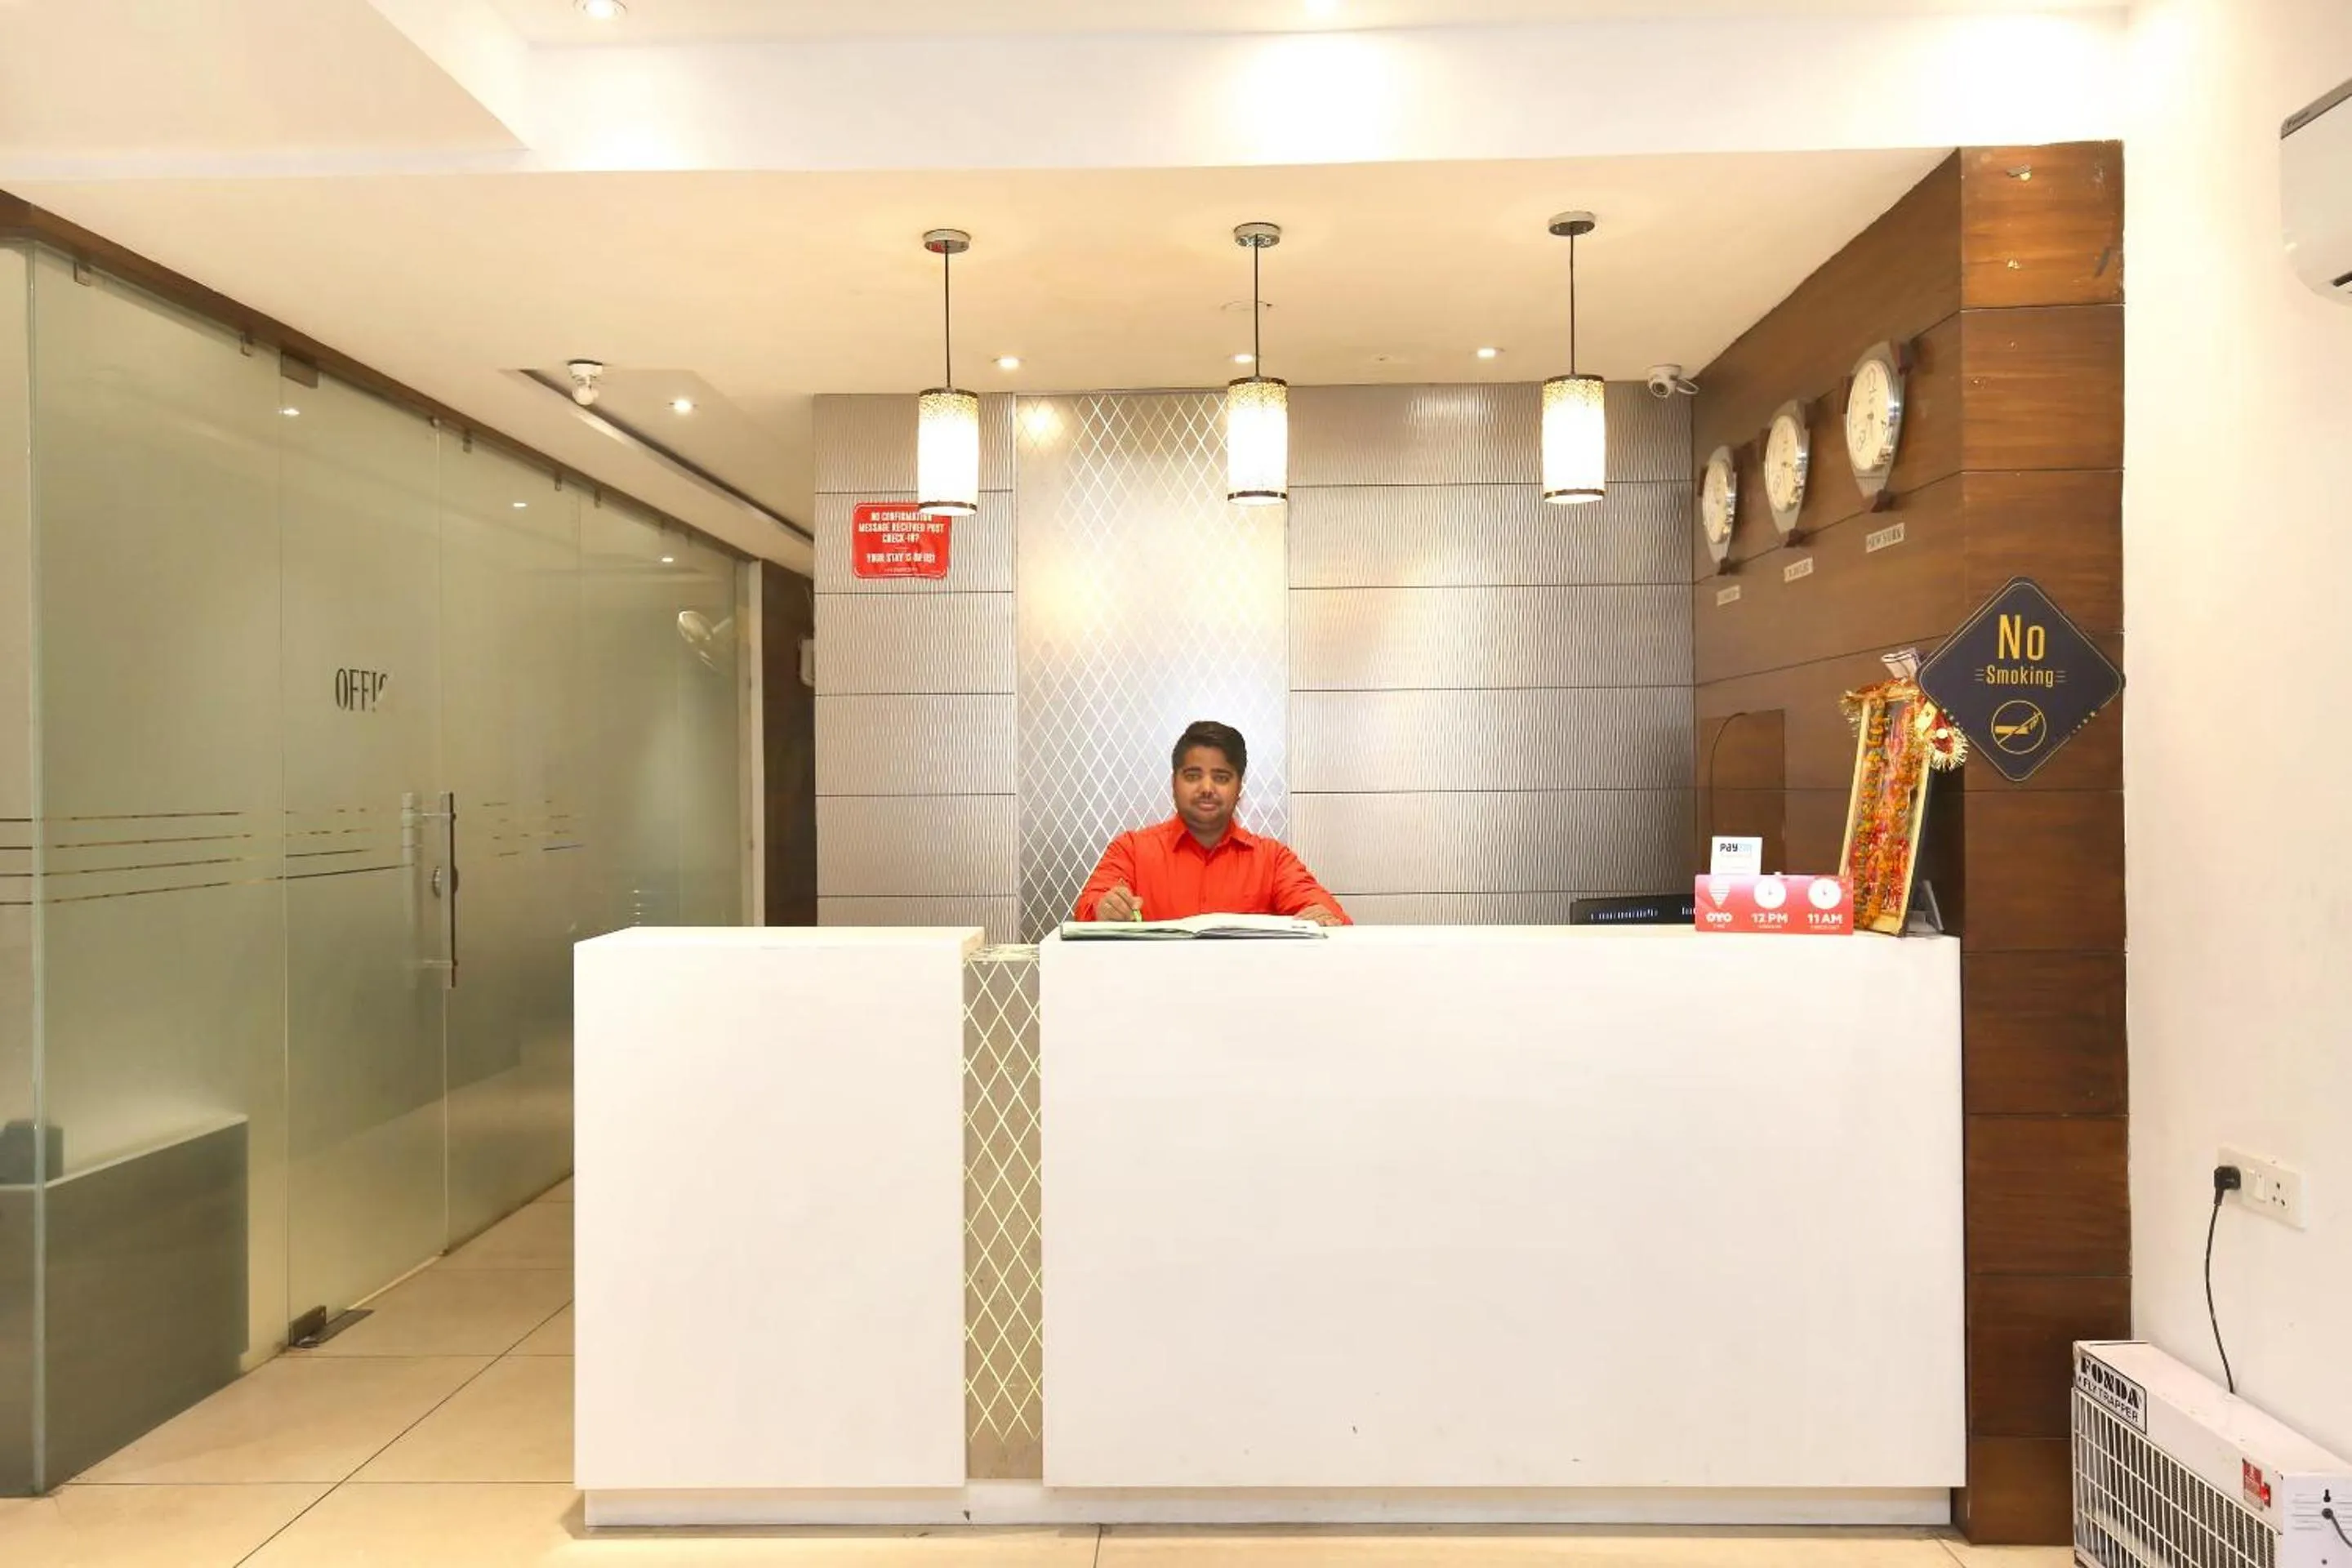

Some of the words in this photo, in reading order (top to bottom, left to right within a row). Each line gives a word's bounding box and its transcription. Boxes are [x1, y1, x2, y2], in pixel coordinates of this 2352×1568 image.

[858, 523, 889, 532] MESSAGE
[892, 523, 925, 532] RECEIVED
[886, 553, 903, 562] STAY
[1998, 613, 2046, 662] No
[1986, 665, 2055, 688] Smoking
[1705, 911, 1733, 924] OYO
[1752, 912, 1765, 924] 12
[1767, 912, 1788, 924] PM
[1807, 913, 1819, 924] 11
[1820, 913, 1843, 924] AM
[2080, 1356, 2140, 1410] FONDA
[2097, 1386, 2139, 1423] TRAPPER
